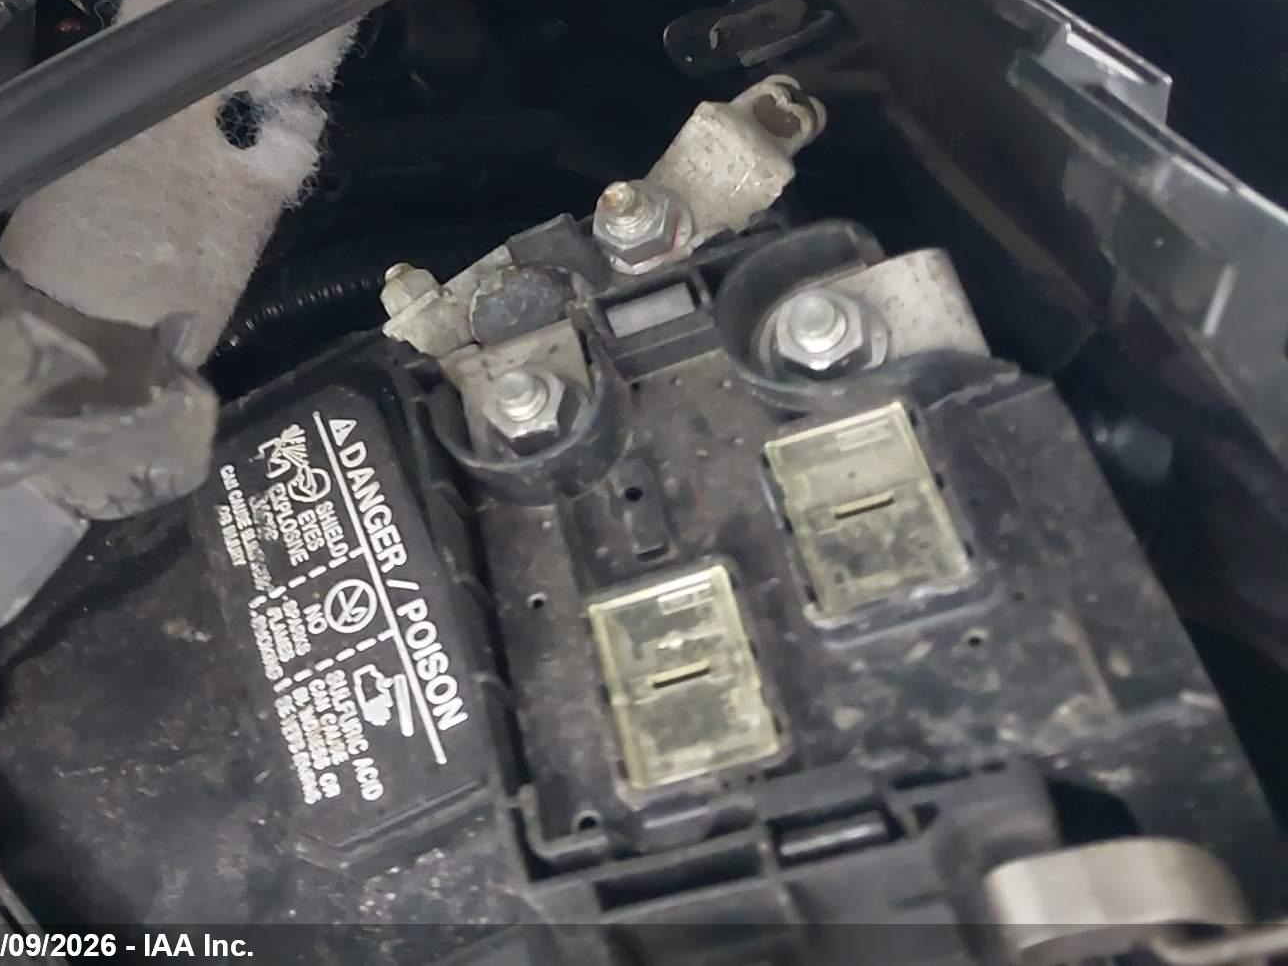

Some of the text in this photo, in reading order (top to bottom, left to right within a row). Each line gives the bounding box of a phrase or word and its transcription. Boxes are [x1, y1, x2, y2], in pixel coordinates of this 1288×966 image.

[267, 483, 309, 566] EXPLOSIVE
[297, 509, 325, 551] EYES
[315, 501, 351, 558] SHIELD
[303, 603, 329, 634] NO
[339, 441, 407, 573] DANGER
[396, 598, 469, 731] POISON
[308, 678, 350, 765] CAN CAUSE
[324, 669, 388, 801] SULFURIC ACID
